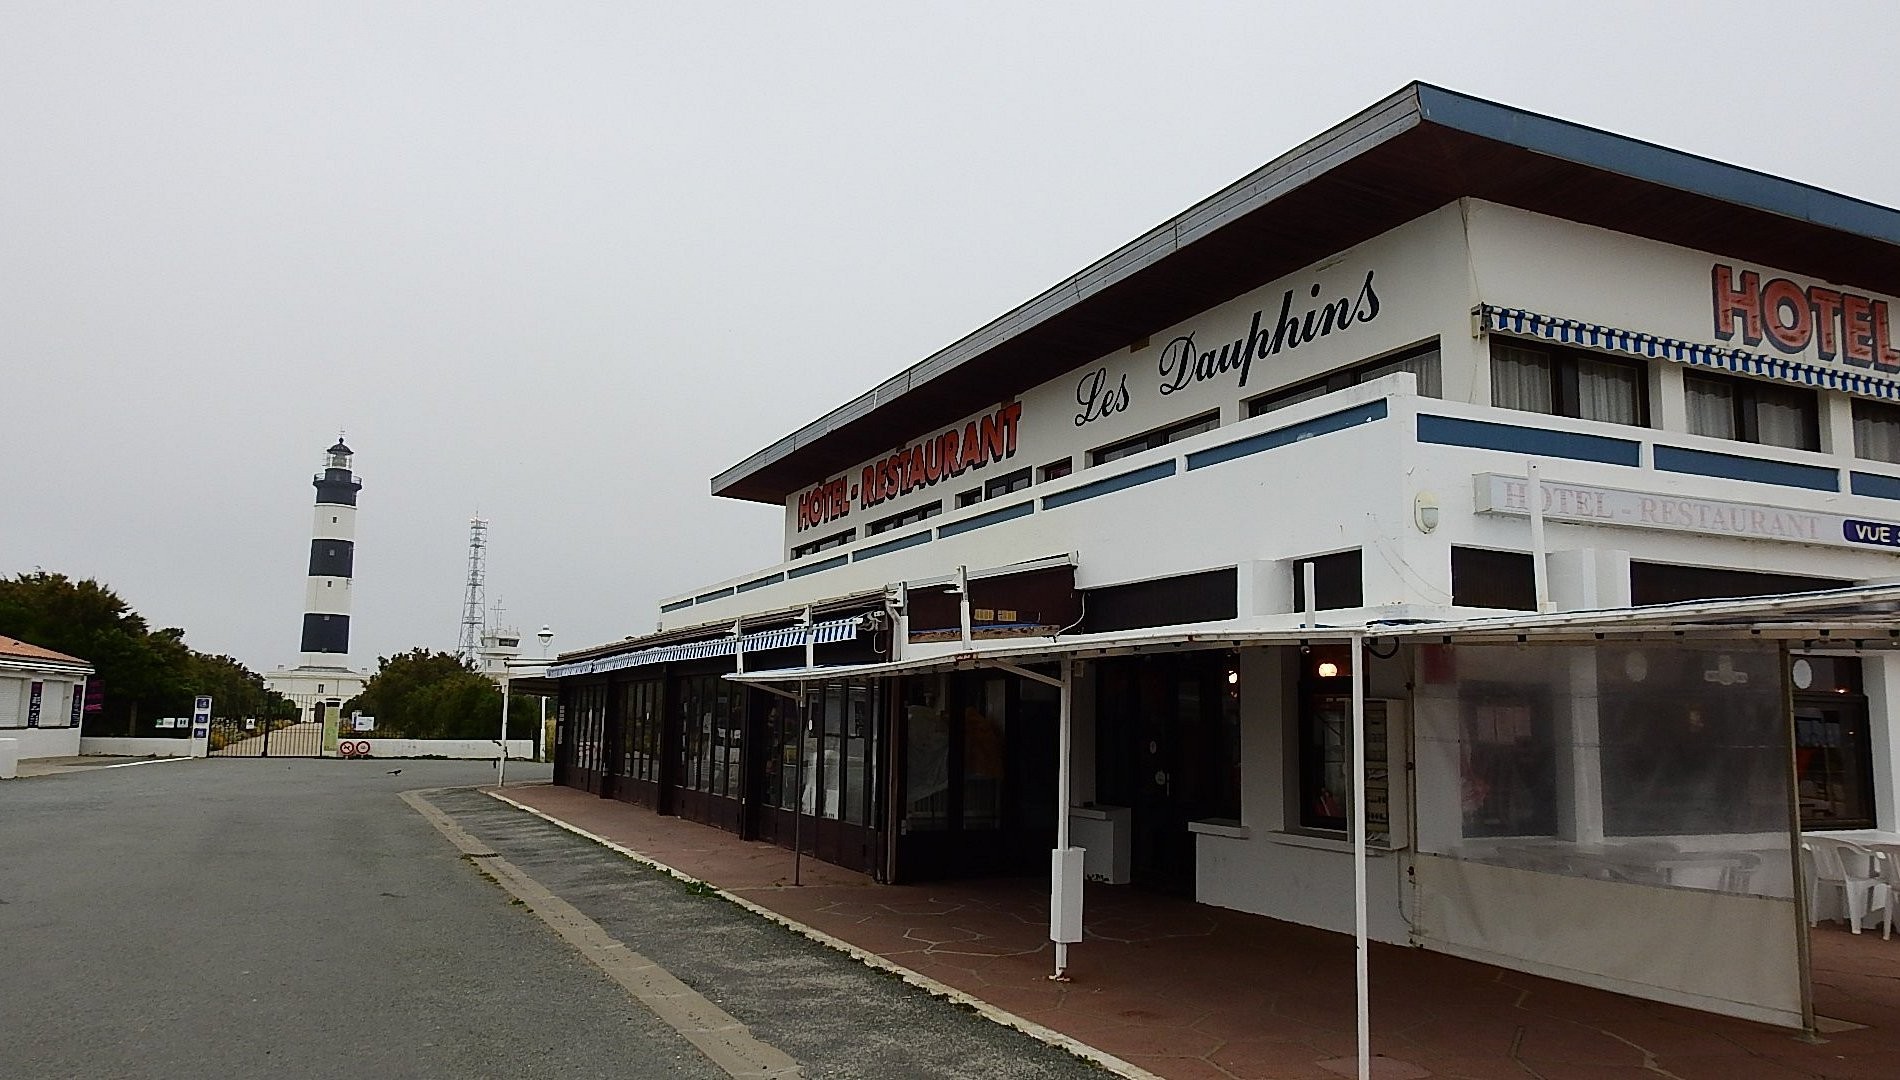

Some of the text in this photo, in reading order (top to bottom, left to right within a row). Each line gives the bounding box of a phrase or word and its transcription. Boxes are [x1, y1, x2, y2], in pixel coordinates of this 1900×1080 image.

[1074, 270, 1380, 427] Les Dauphins
[1711, 263, 1900, 375] HOTEL
[861, 401, 1022, 511] RESTAURANT
[1640, 498, 1821, 540] RESTAURANT
[1855, 524, 1891, 543] VUE
